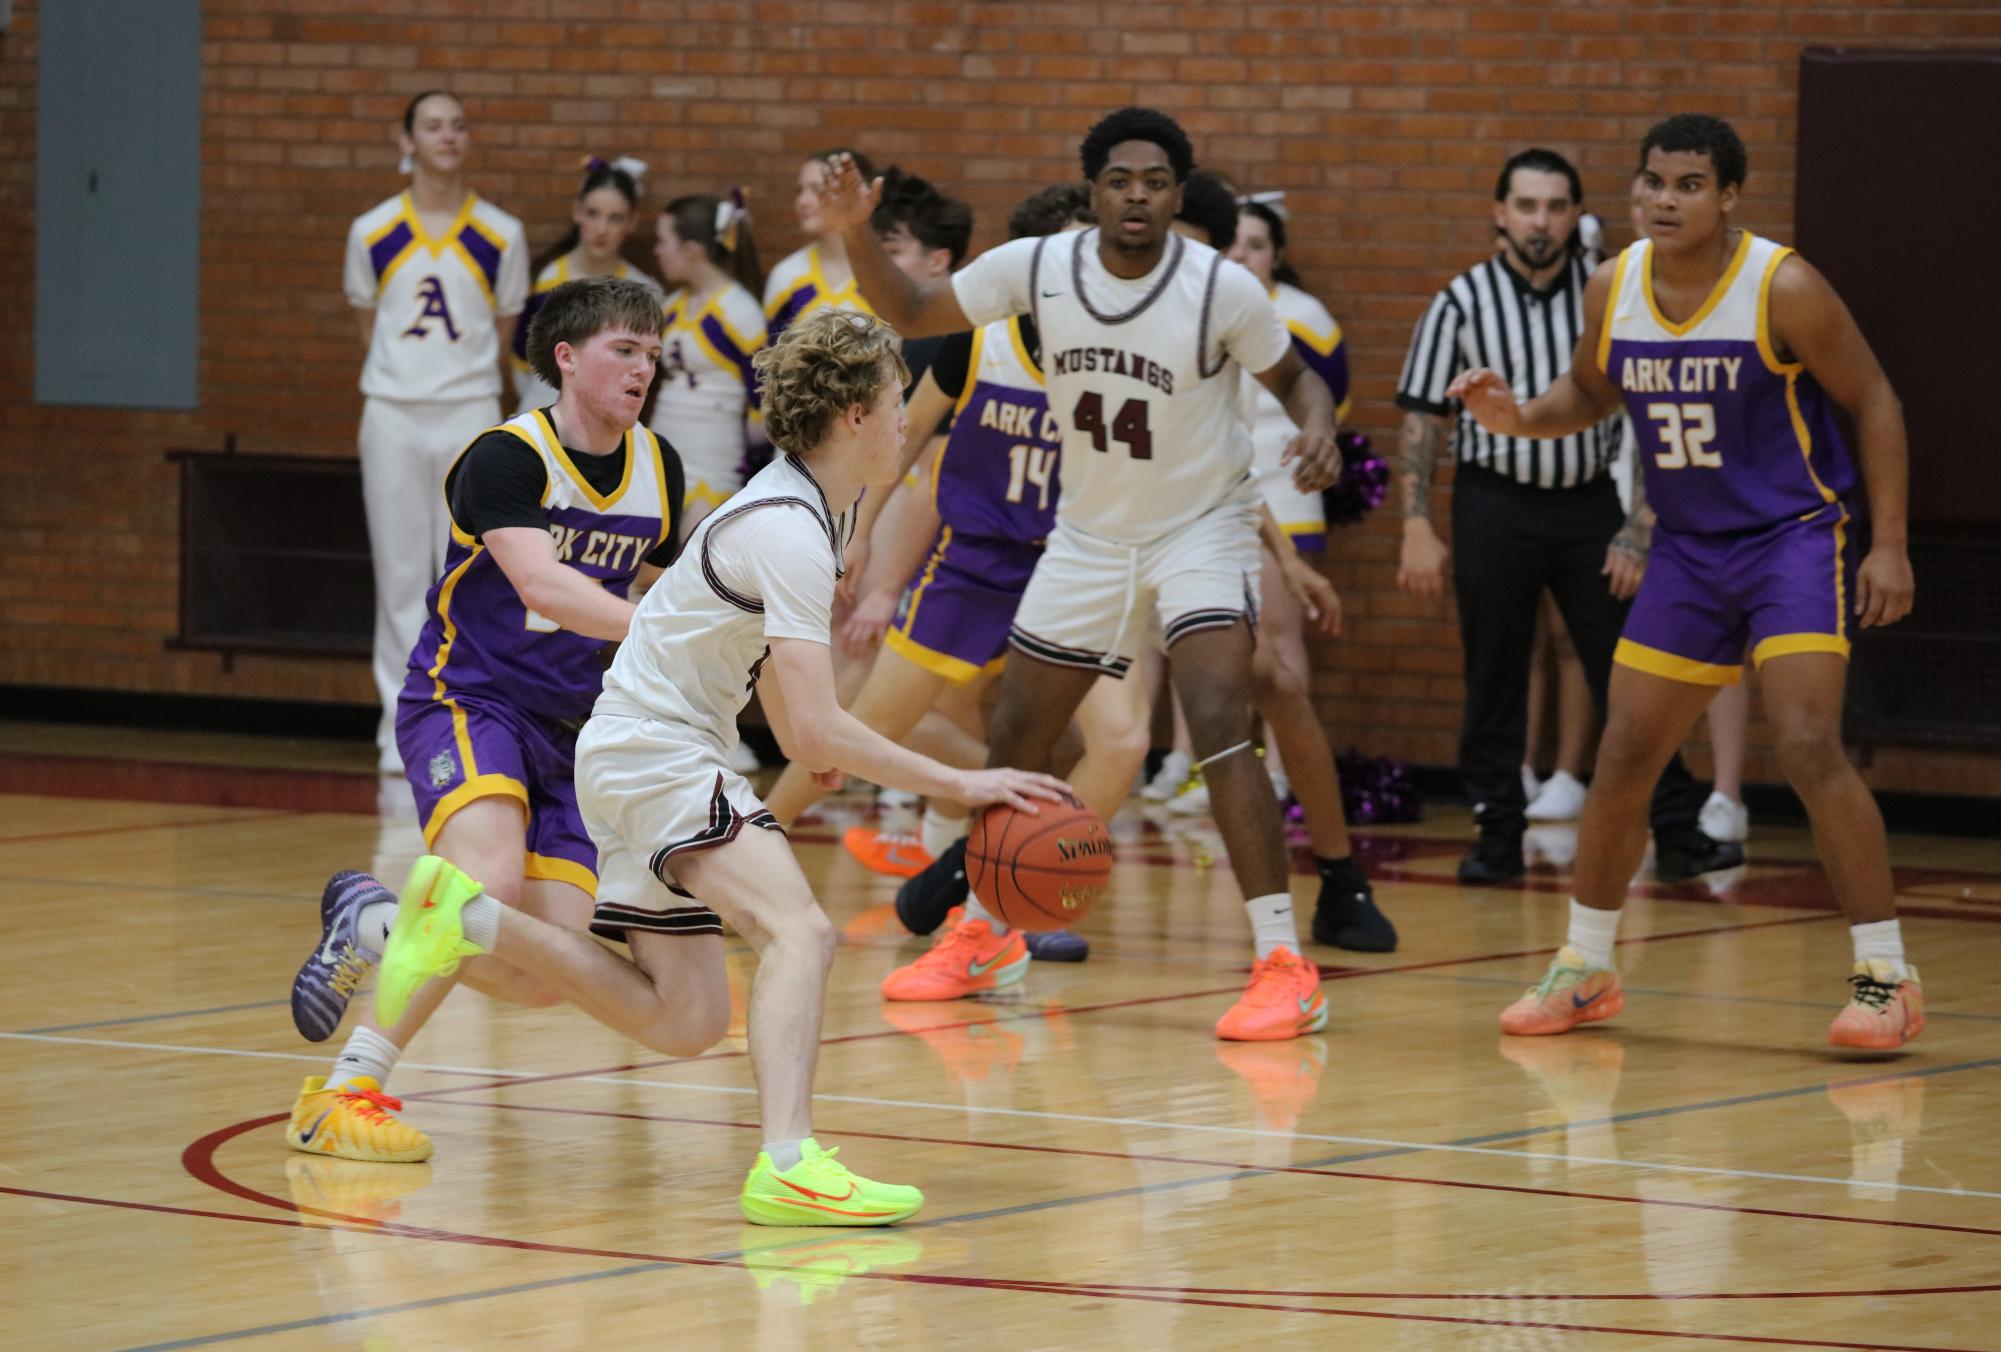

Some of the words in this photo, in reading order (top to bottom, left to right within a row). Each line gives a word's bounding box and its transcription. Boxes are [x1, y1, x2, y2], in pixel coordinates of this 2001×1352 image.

[400, 274, 463, 343] A
[1053, 347, 1174, 396] MUSTANGS
[1622, 357, 1674, 392] ARK
[1680, 357, 1742, 392] CITY
[980, 399, 1037, 438] ARK
[1072, 390, 1152, 460] 44
[1647, 402, 1723, 469] 32
[1006, 444, 1058, 511] 14
[549, 523, 584, 561] RK
[580, 530, 652, 572] CITY
